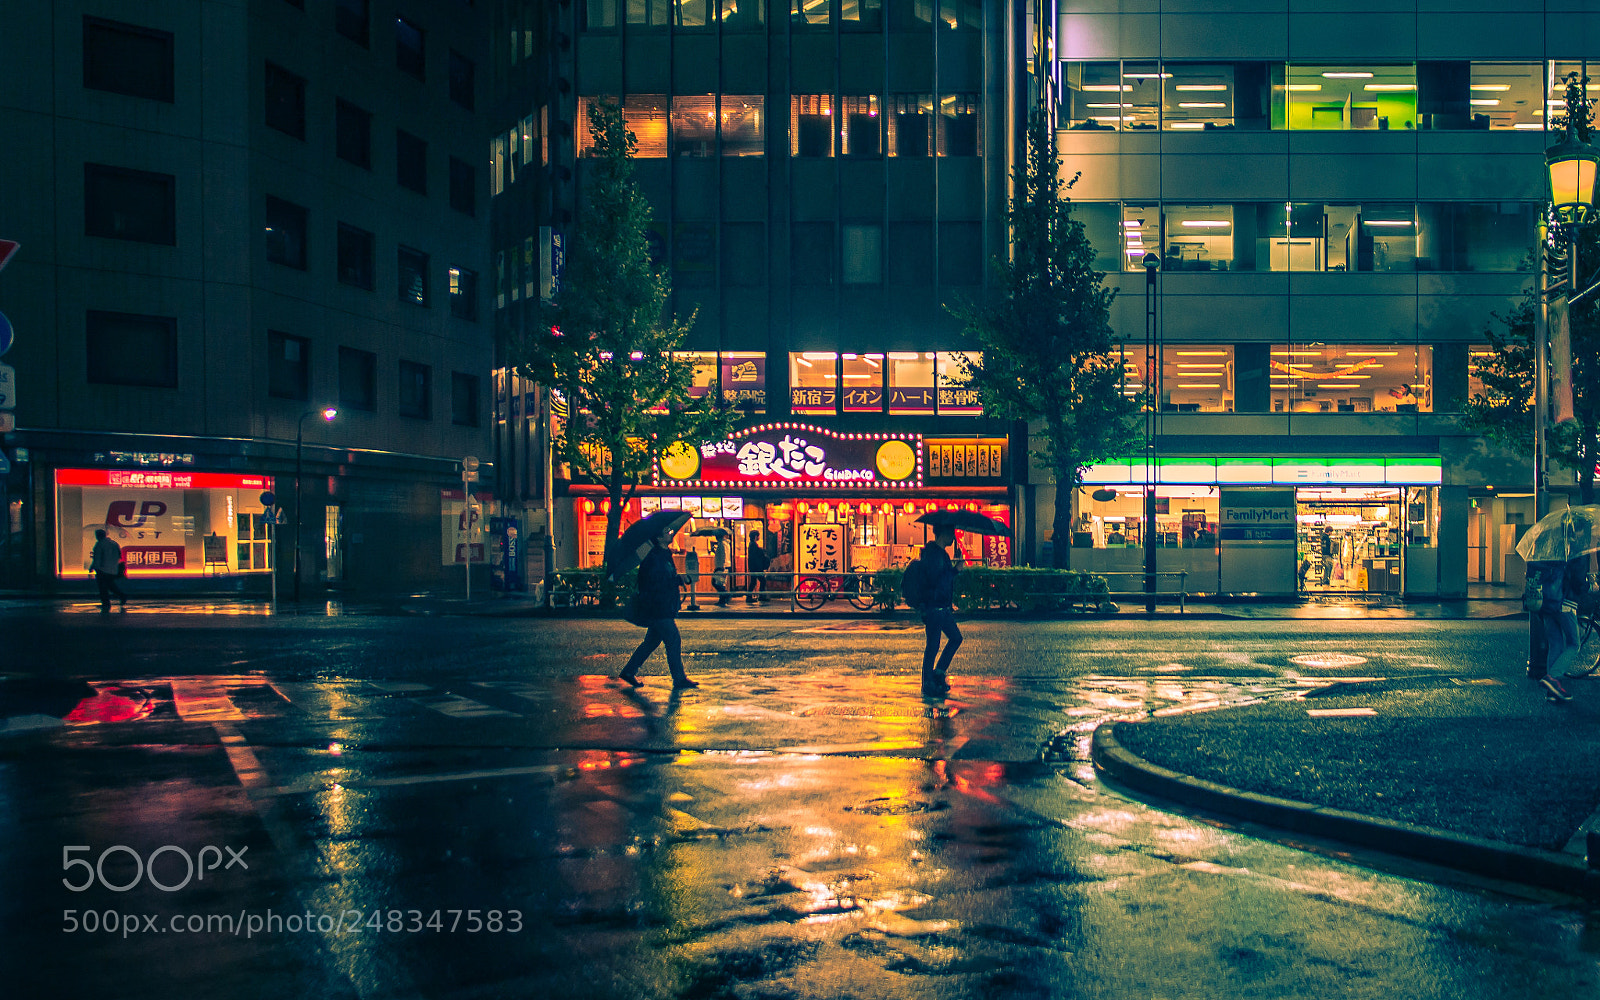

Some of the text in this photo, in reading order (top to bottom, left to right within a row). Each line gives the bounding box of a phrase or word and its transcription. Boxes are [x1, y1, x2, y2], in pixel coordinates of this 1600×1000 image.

[736, 434, 827, 479] 銀だこ
[824, 468, 874, 480] GINDACO
[1311, 470, 1361, 479] FamilyMart
[105, 500, 168, 528] JP
[1226, 509, 1289, 523] FamilyMart
[126, 551, 178, 566] 郵便局
[803, 527, 821, 570] 焼そば
[818, 529, 838, 573] たこ焼
